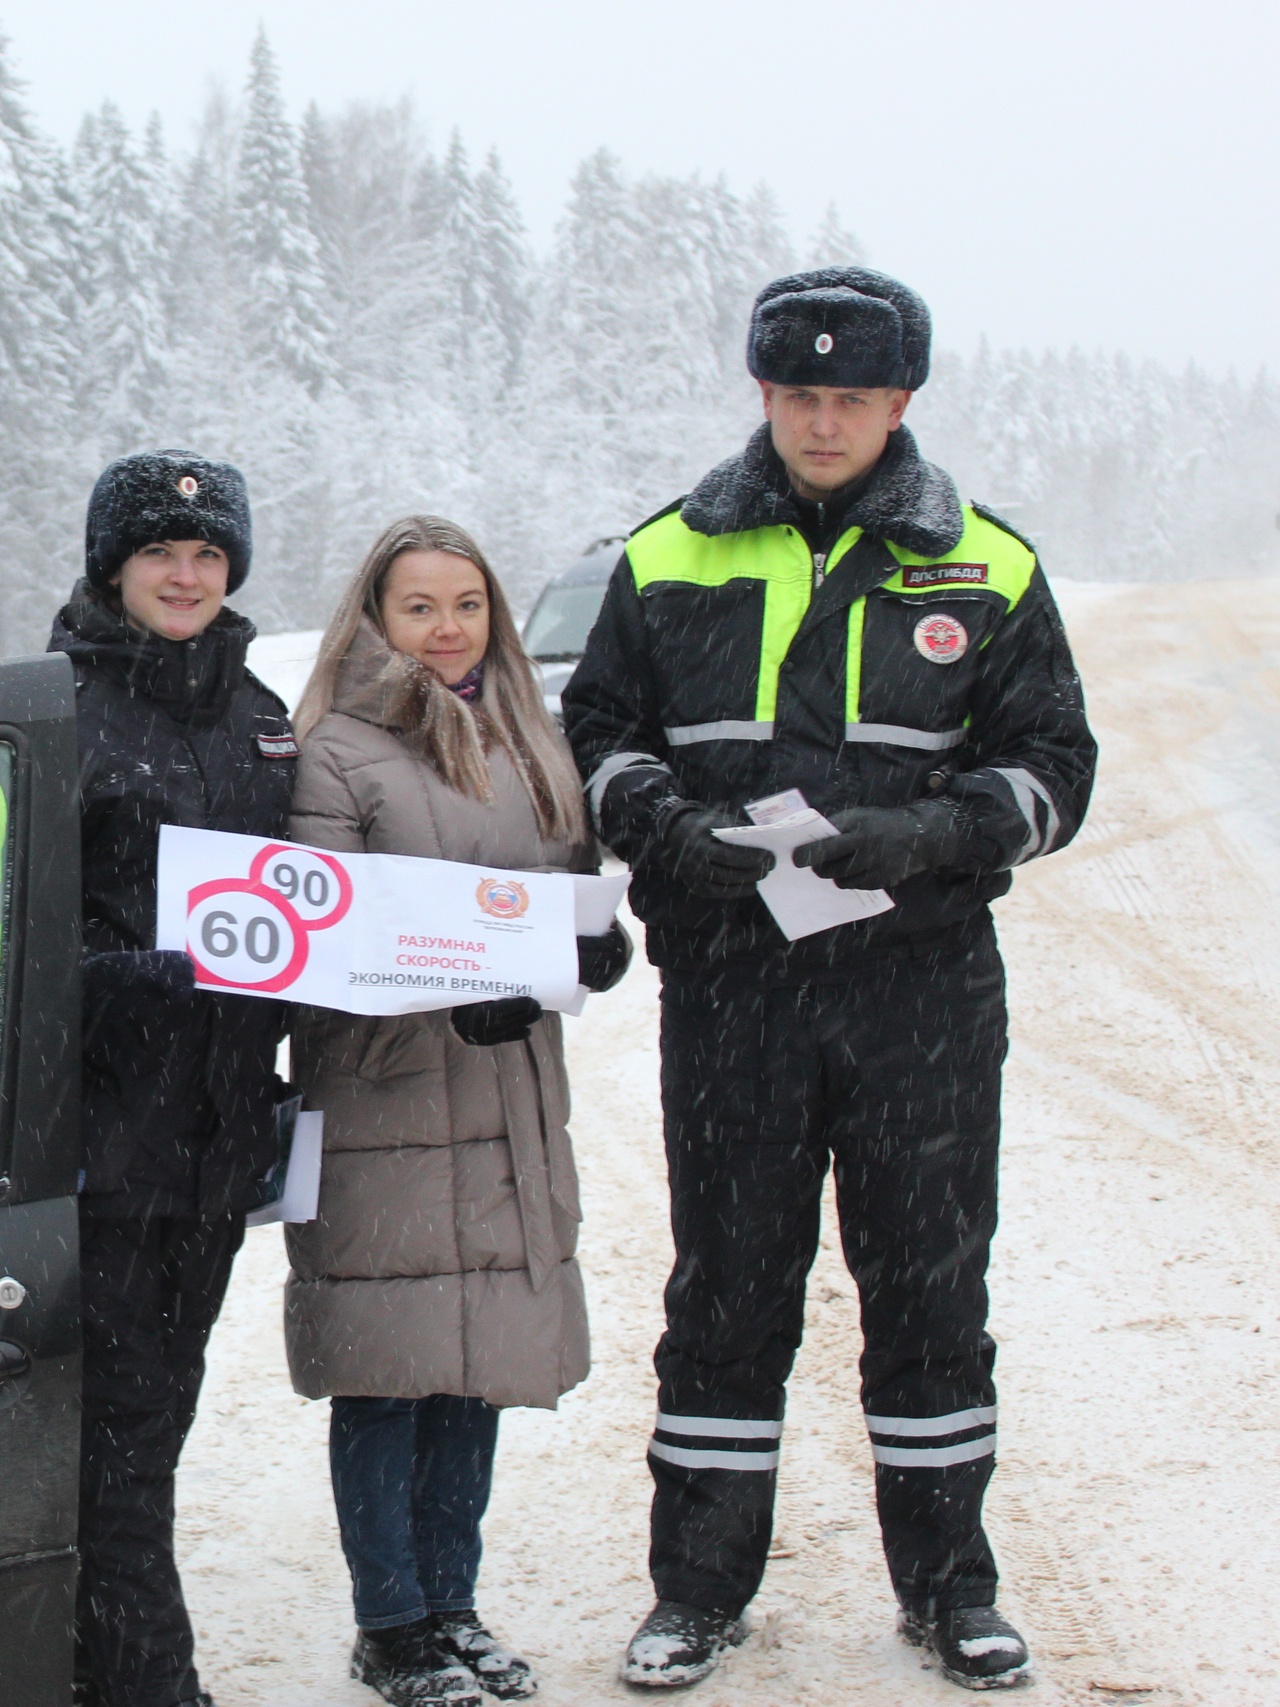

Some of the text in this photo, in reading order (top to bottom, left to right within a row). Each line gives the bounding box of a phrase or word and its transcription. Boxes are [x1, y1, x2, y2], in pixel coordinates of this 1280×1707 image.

[273, 863, 329, 907] 90
[201, 910, 280, 964] 60
[398, 934, 487, 954] РАЗУМНАЯ
[396, 954, 481, 971] СКОРОСТЬ
[348, 971, 532, 997] ЭКОНОМИЯ ВРЕМЕНИ!
